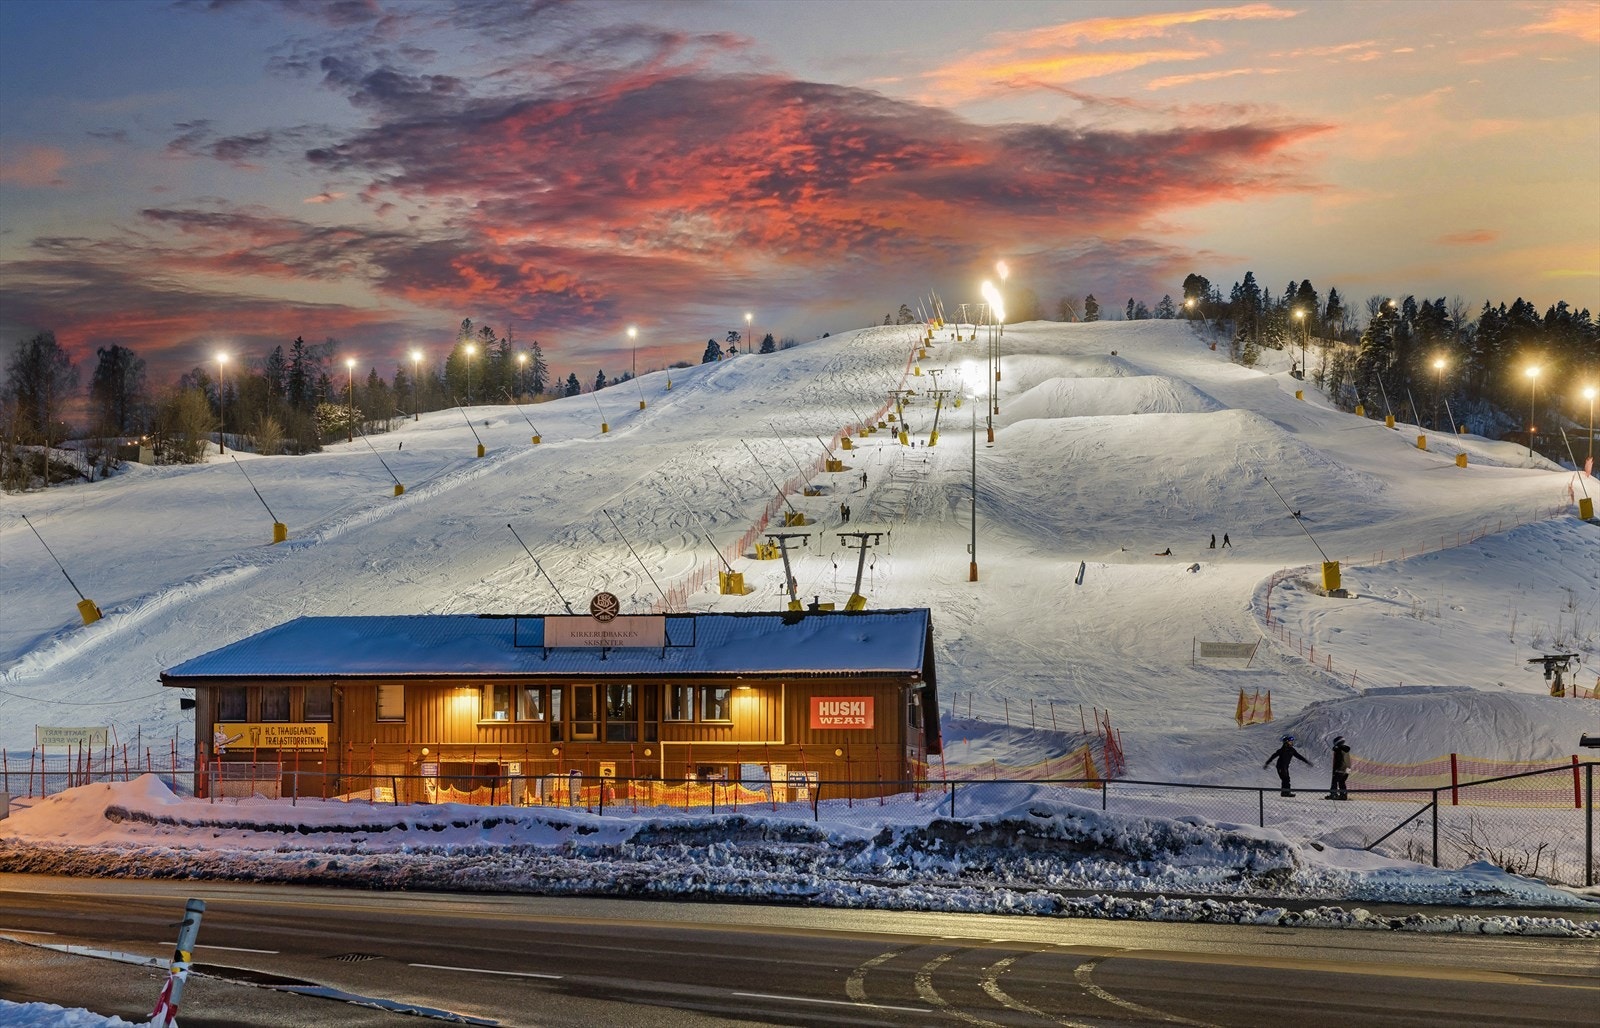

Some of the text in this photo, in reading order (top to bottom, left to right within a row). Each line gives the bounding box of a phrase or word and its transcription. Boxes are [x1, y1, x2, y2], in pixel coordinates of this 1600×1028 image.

[819, 701, 865, 716] HUSKI
[819, 717, 866, 725] WEAR
[278, 726, 317, 736] THAUGLANDS
